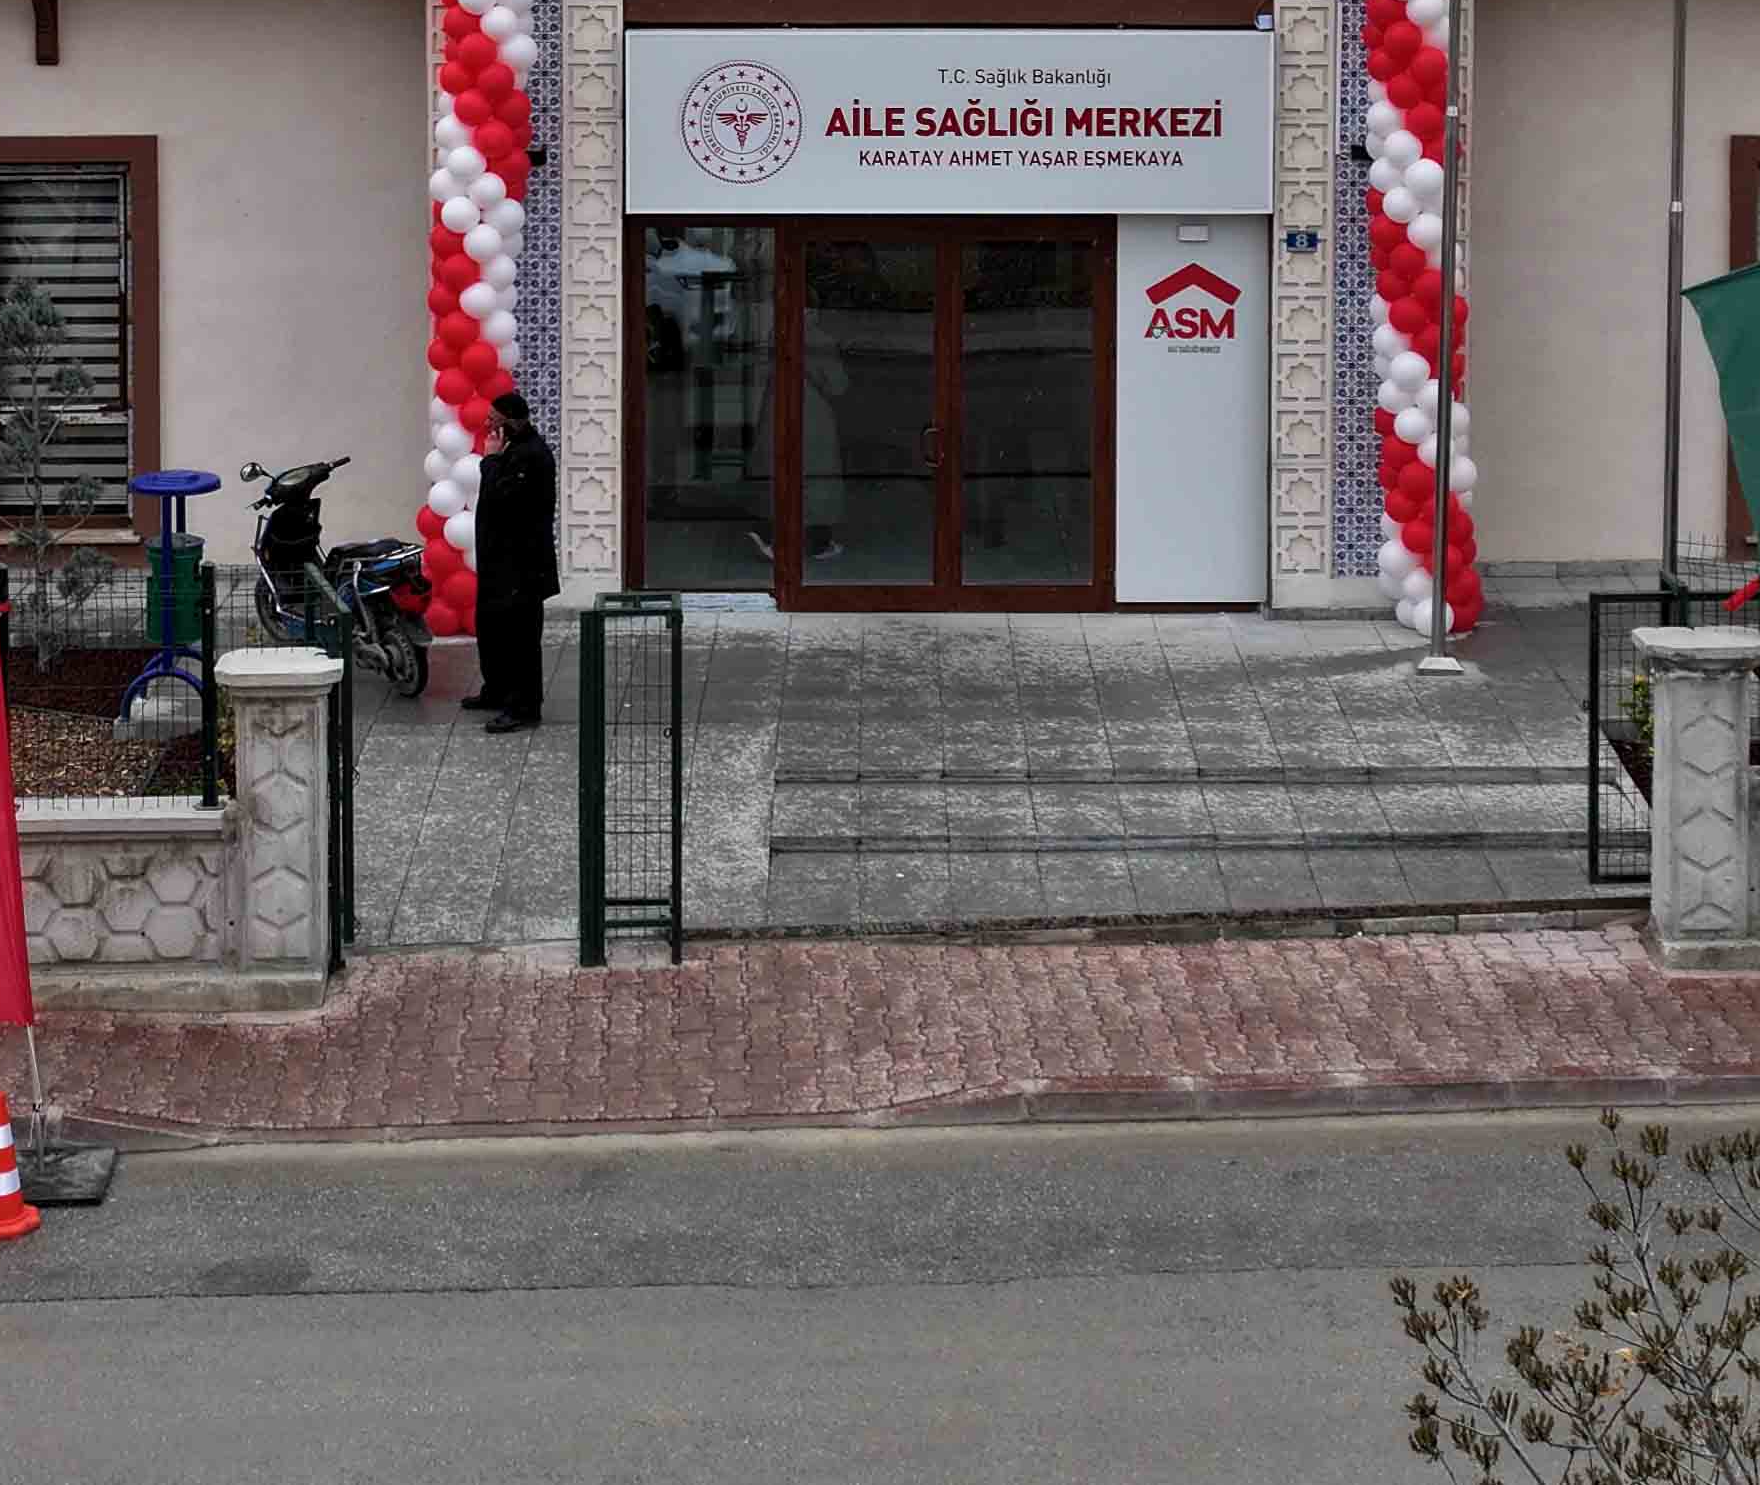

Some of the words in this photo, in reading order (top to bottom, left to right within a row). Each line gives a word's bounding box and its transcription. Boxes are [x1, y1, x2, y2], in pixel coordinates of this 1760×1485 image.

[938, 69, 969, 84] T.C.
[975, 68, 1027, 88] Sağlık
[1032, 68, 1111, 88] Bakanlığı
[824, 99, 906, 136] AİLE
[915, 99, 1053, 137] SAĞLIĞI
[1065, 99, 1222, 137] MERKEZİ
[859, 150, 944, 166] KARATAY
[948, 150, 1013, 166] AHMET
[1018, 150, 1078, 169] YAŞAR
[1084, 150, 1184, 169] EŞMEKAYA
[1295, 233, 1308, 248] 8
[1144, 308, 1235, 339] ASM
